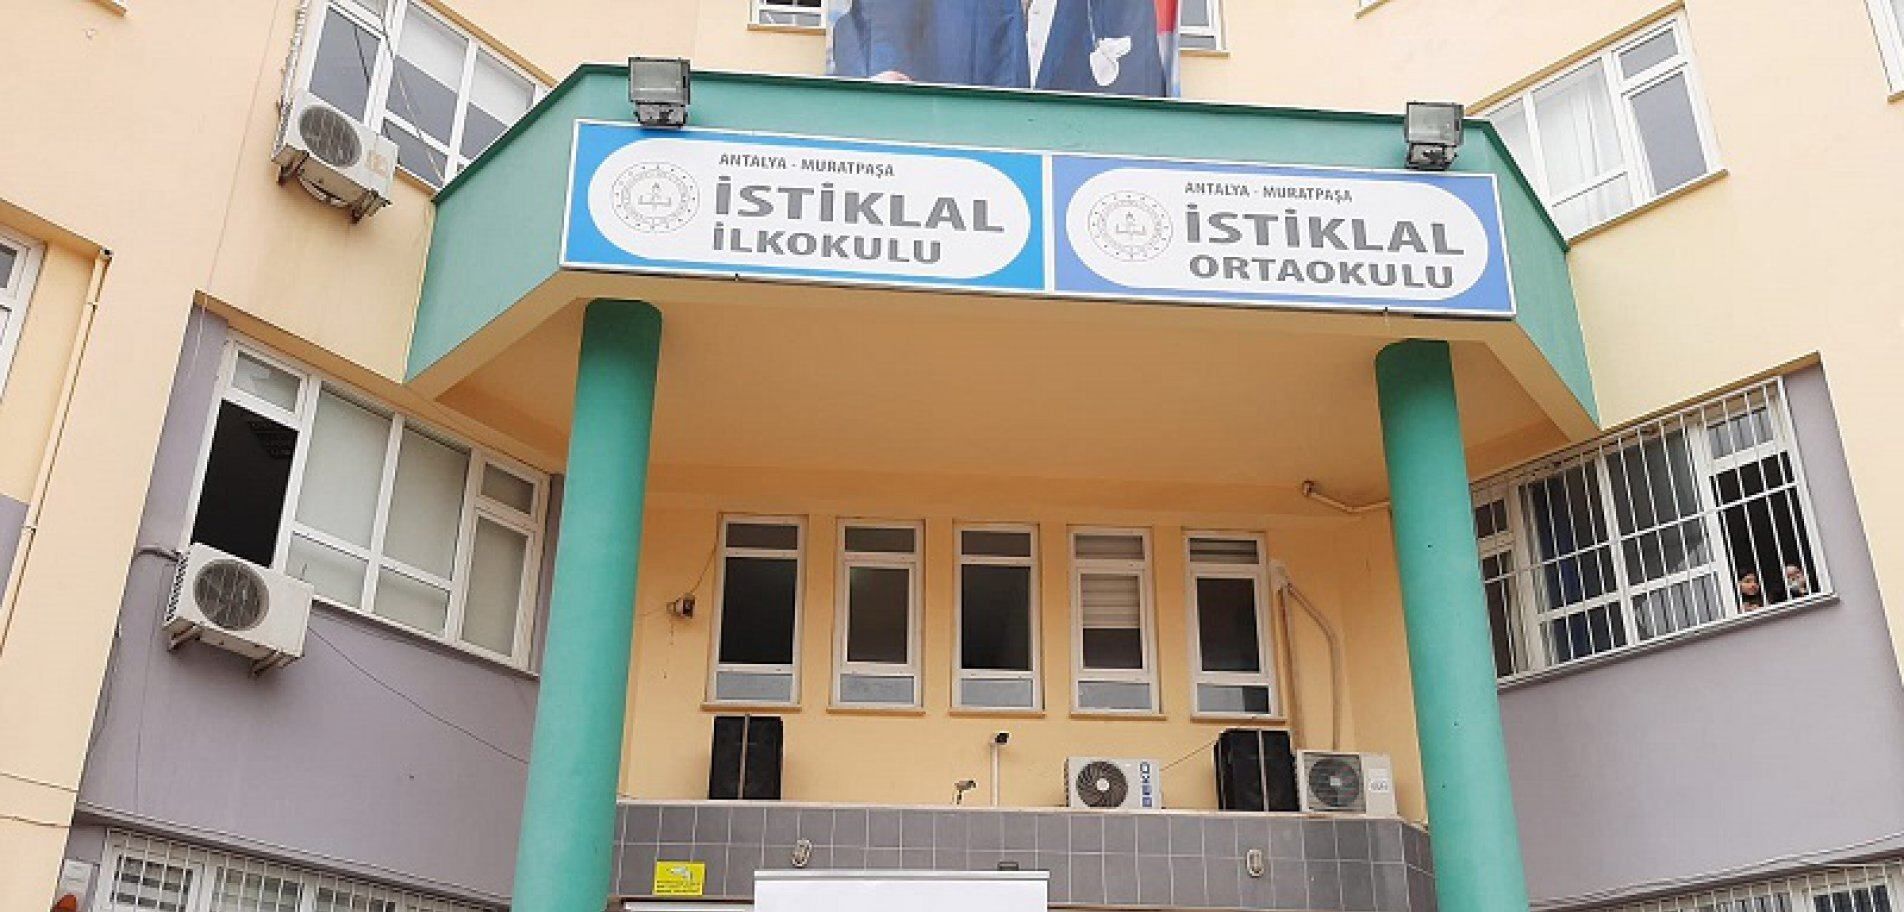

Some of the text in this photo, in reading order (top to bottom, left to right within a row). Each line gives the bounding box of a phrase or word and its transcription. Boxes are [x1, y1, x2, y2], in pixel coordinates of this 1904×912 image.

[719, 153, 787, 169] ANTALYA
[802, 159, 894, 178] MURATPAŞA
[716, 176, 1004, 232] İSTİKLAL
[1185, 182, 1250, 197] ANTALYA
[1263, 186, 1352, 203] MURATPAŞA
[714, 222, 940, 264] İLKOKULU
[1187, 204, 1464, 255] İSTİKLAL
[1190, 255, 1453, 288] ORTAOKULU
